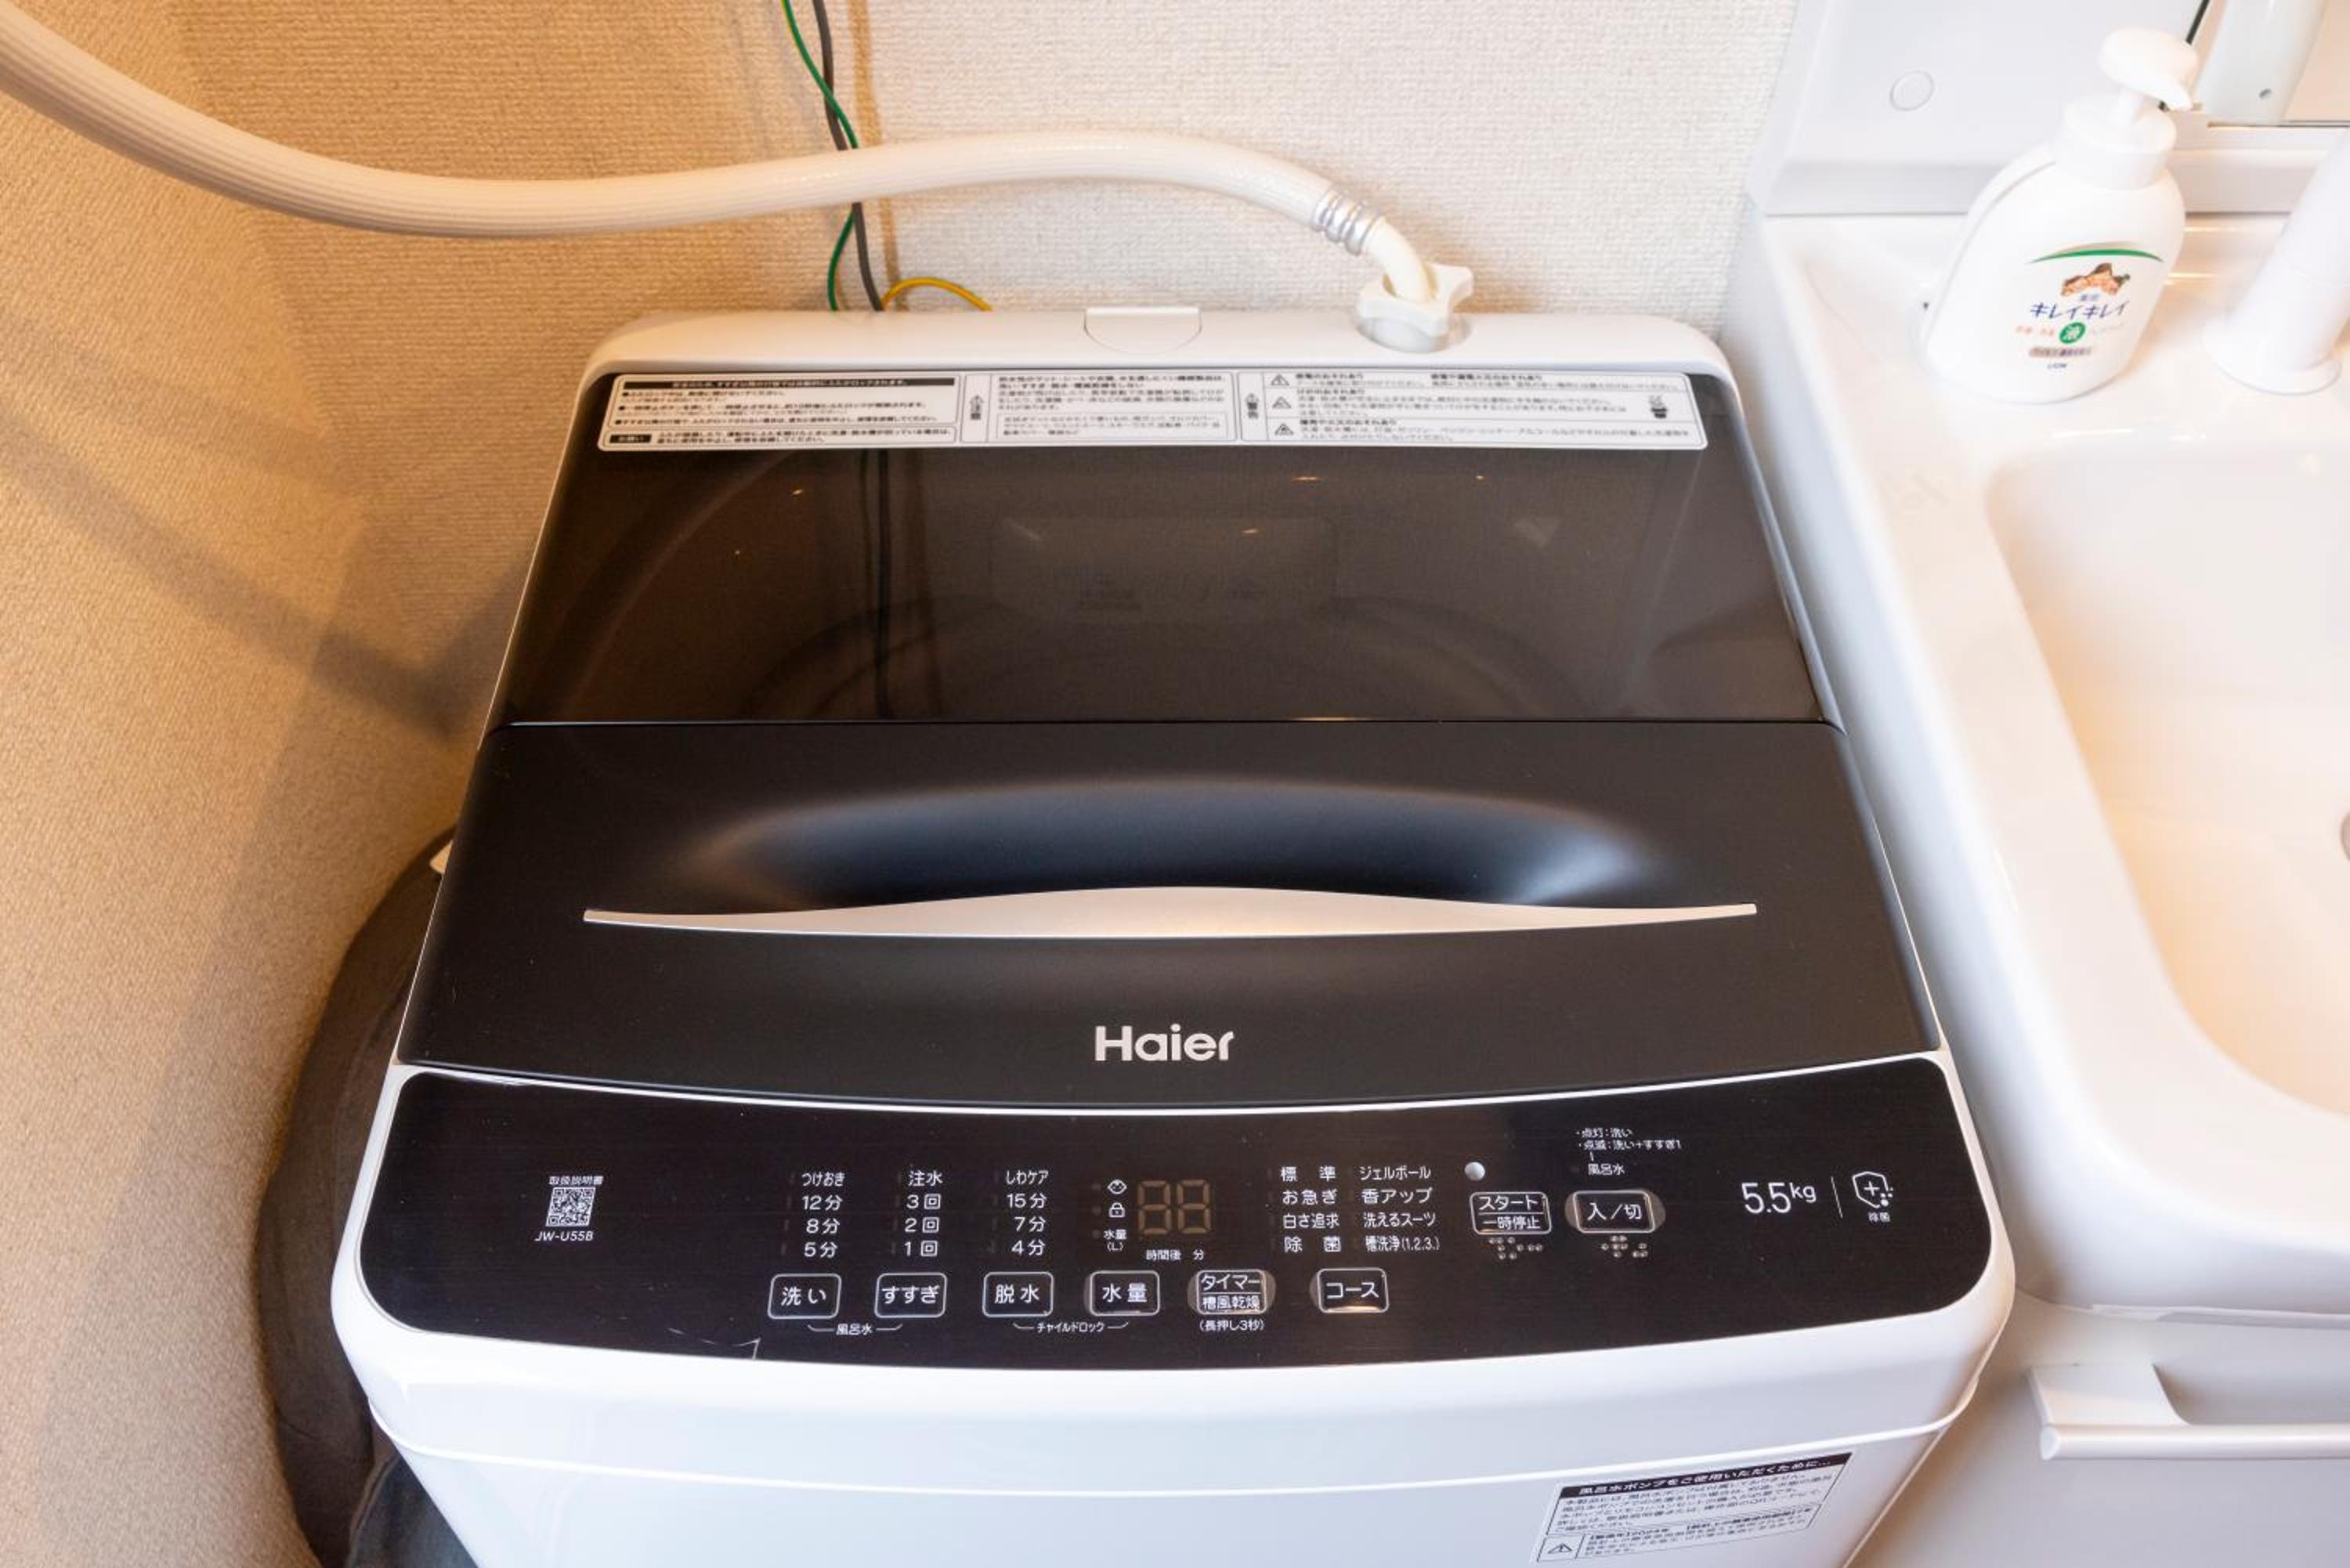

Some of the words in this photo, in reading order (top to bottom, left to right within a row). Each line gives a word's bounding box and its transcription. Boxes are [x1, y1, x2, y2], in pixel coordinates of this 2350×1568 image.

[2030, 302, 2130, 320] キレイキレイ
[1096, 1024, 1234, 1060] Haier
[1007, 1170, 1048, 1184] しわケア
[1281, 1165, 1336, 1182] 標準
[1589, 1164, 1625, 1175] 風呂水
[802, 1172, 844, 1187] つけおき
[909, 1170, 942, 1186] 注水
[803, 1195, 842, 1210] 12分
[907, 1194, 941, 1209] 3回
[1007, 1193, 1047, 1209] 15分
[1283, 1189, 1337, 1205] お急ぎ
[1479, 1195, 1537, 1210] スタート
[807, 1219, 840, 1234] 8分
[905, 1217, 939, 1233] 2回
[1015, 1216, 1046, 1232] 7分
[1283, 1212, 1339, 1229] 白さ追求
[1364, 1212, 1435, 1228] 洗えるスーツ
[1481, 1216, 1540, 1231] 一時停止
[535, 1231, 593, 1241] JW-U55B
[1285, 1236, 1341, 1252] 除菌
[804, 1242, 837, 1258] 5分
[905, 1241, 938, 1256] 1回
[1012, 1239, 1045, 1255] 4分
[1193, 1249, 1204, 1259] 分
[1201, 1274, 1260, 1292] タイマー
[1327, 1282, 1379, 1299] コース
[781, 1286, 826, 1306] 洗い
[882, 1286, 940, 1305] すすぎ
[995, 1284, 1039, 1303] 脱水
[1103, 1283, 1147, 1302] 水量
[836, 1324, 873, 1335] 風呂水
